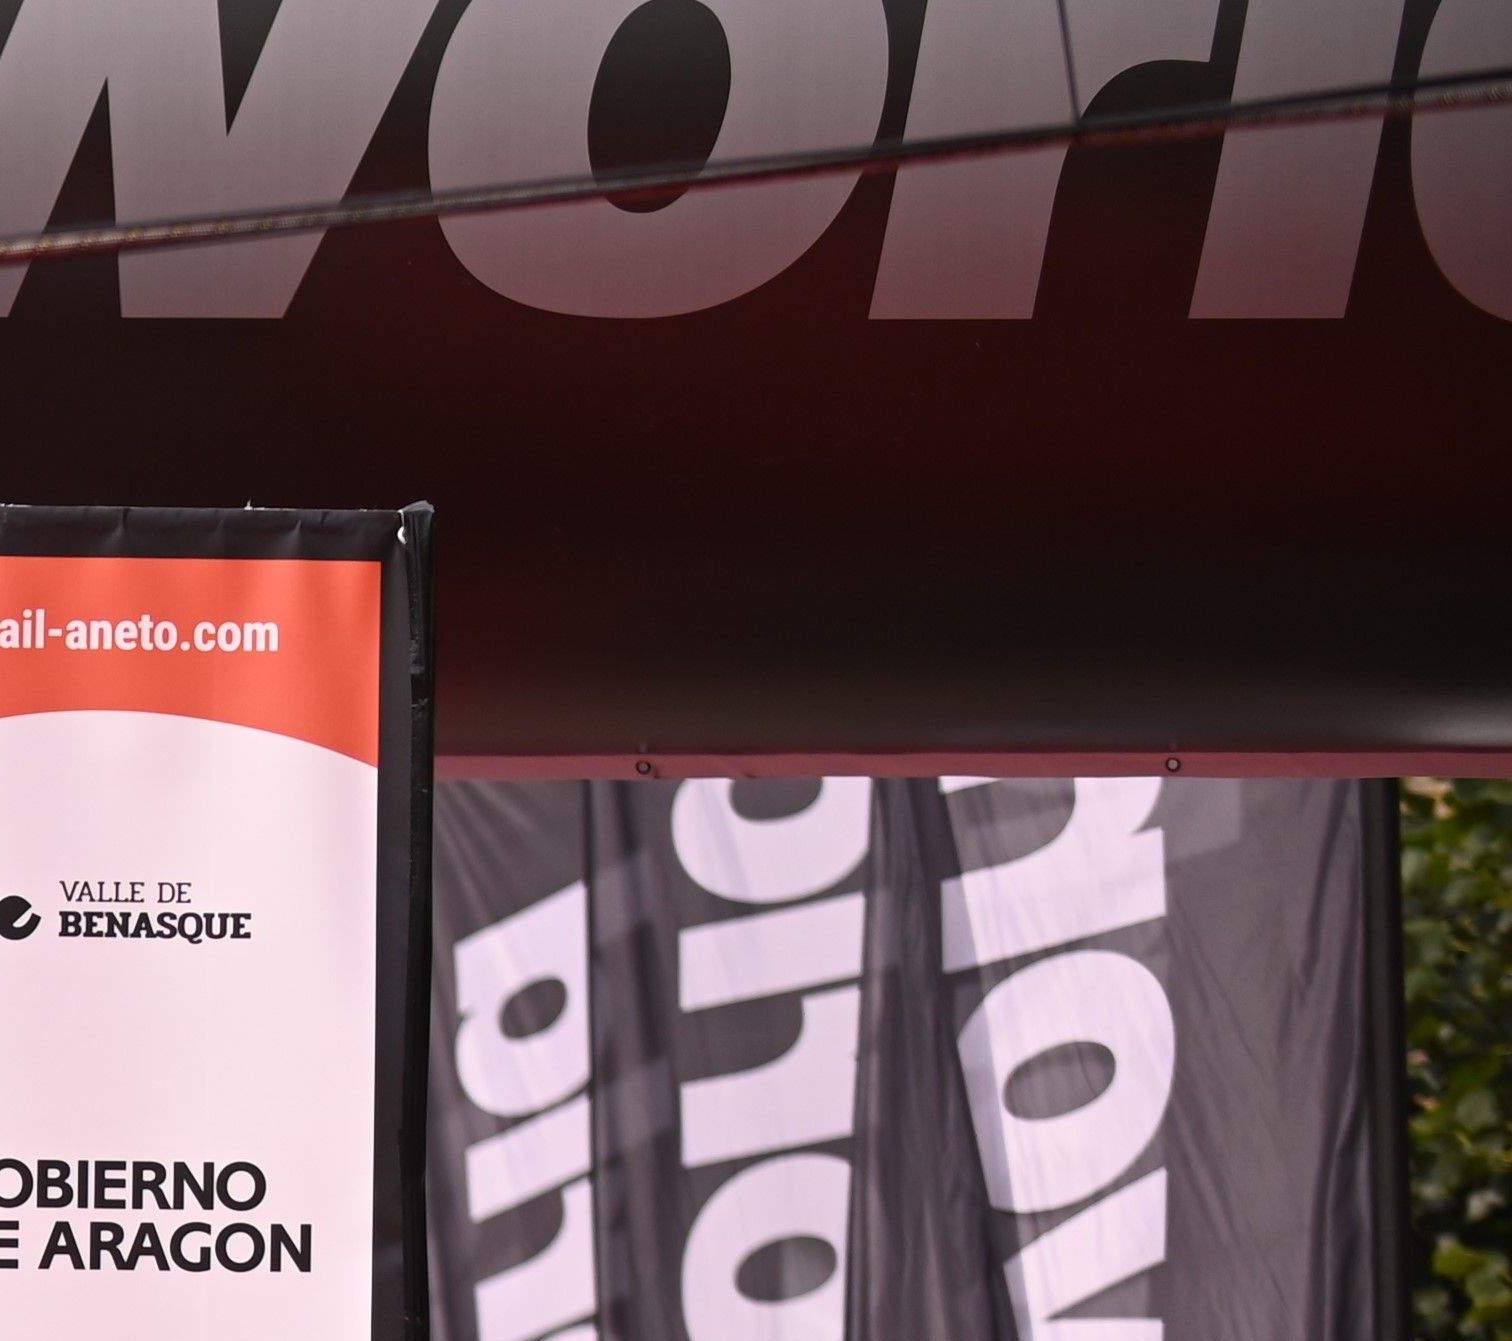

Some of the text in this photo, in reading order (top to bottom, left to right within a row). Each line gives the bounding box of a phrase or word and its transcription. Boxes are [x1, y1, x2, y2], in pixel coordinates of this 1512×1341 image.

[59, 880, 192, 904] VALLE DE
[58, 912, 252, 943] BENASQUE
[38, 1221, 312, 1273] ARAGON
